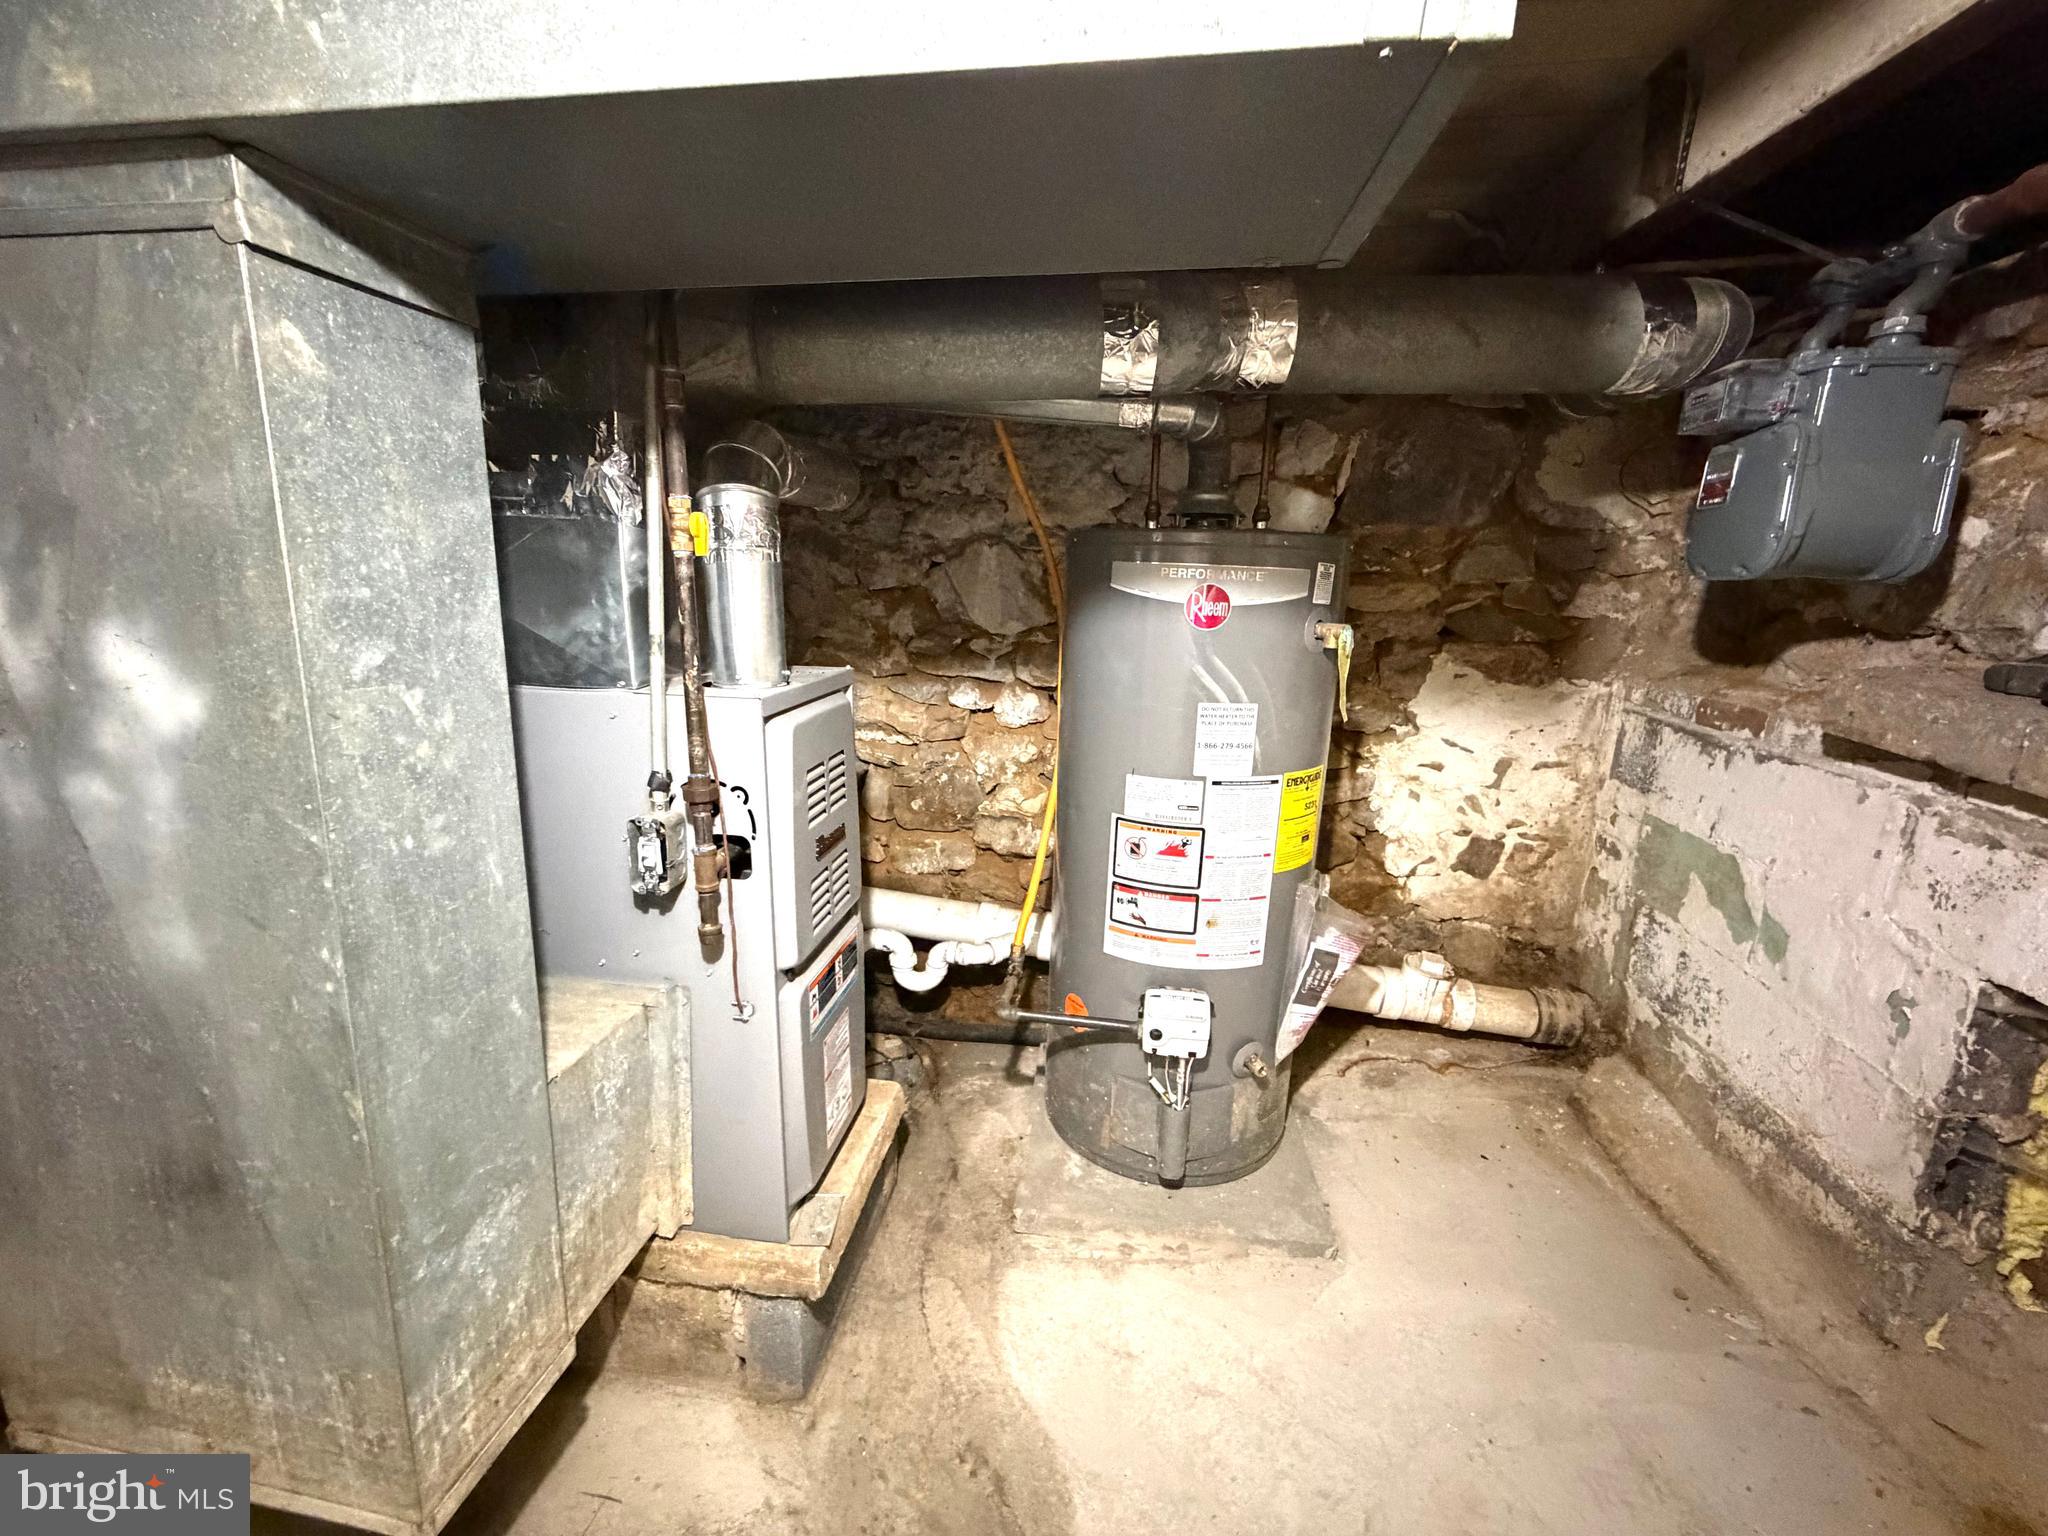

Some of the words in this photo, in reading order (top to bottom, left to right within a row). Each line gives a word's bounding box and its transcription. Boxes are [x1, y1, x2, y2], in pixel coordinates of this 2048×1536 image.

[1160, 567, 1265, 582] PERFORMANCE
[1189, 584, 1229, 624] Rheem
[1146, 826, 1178, 835] WARNING
